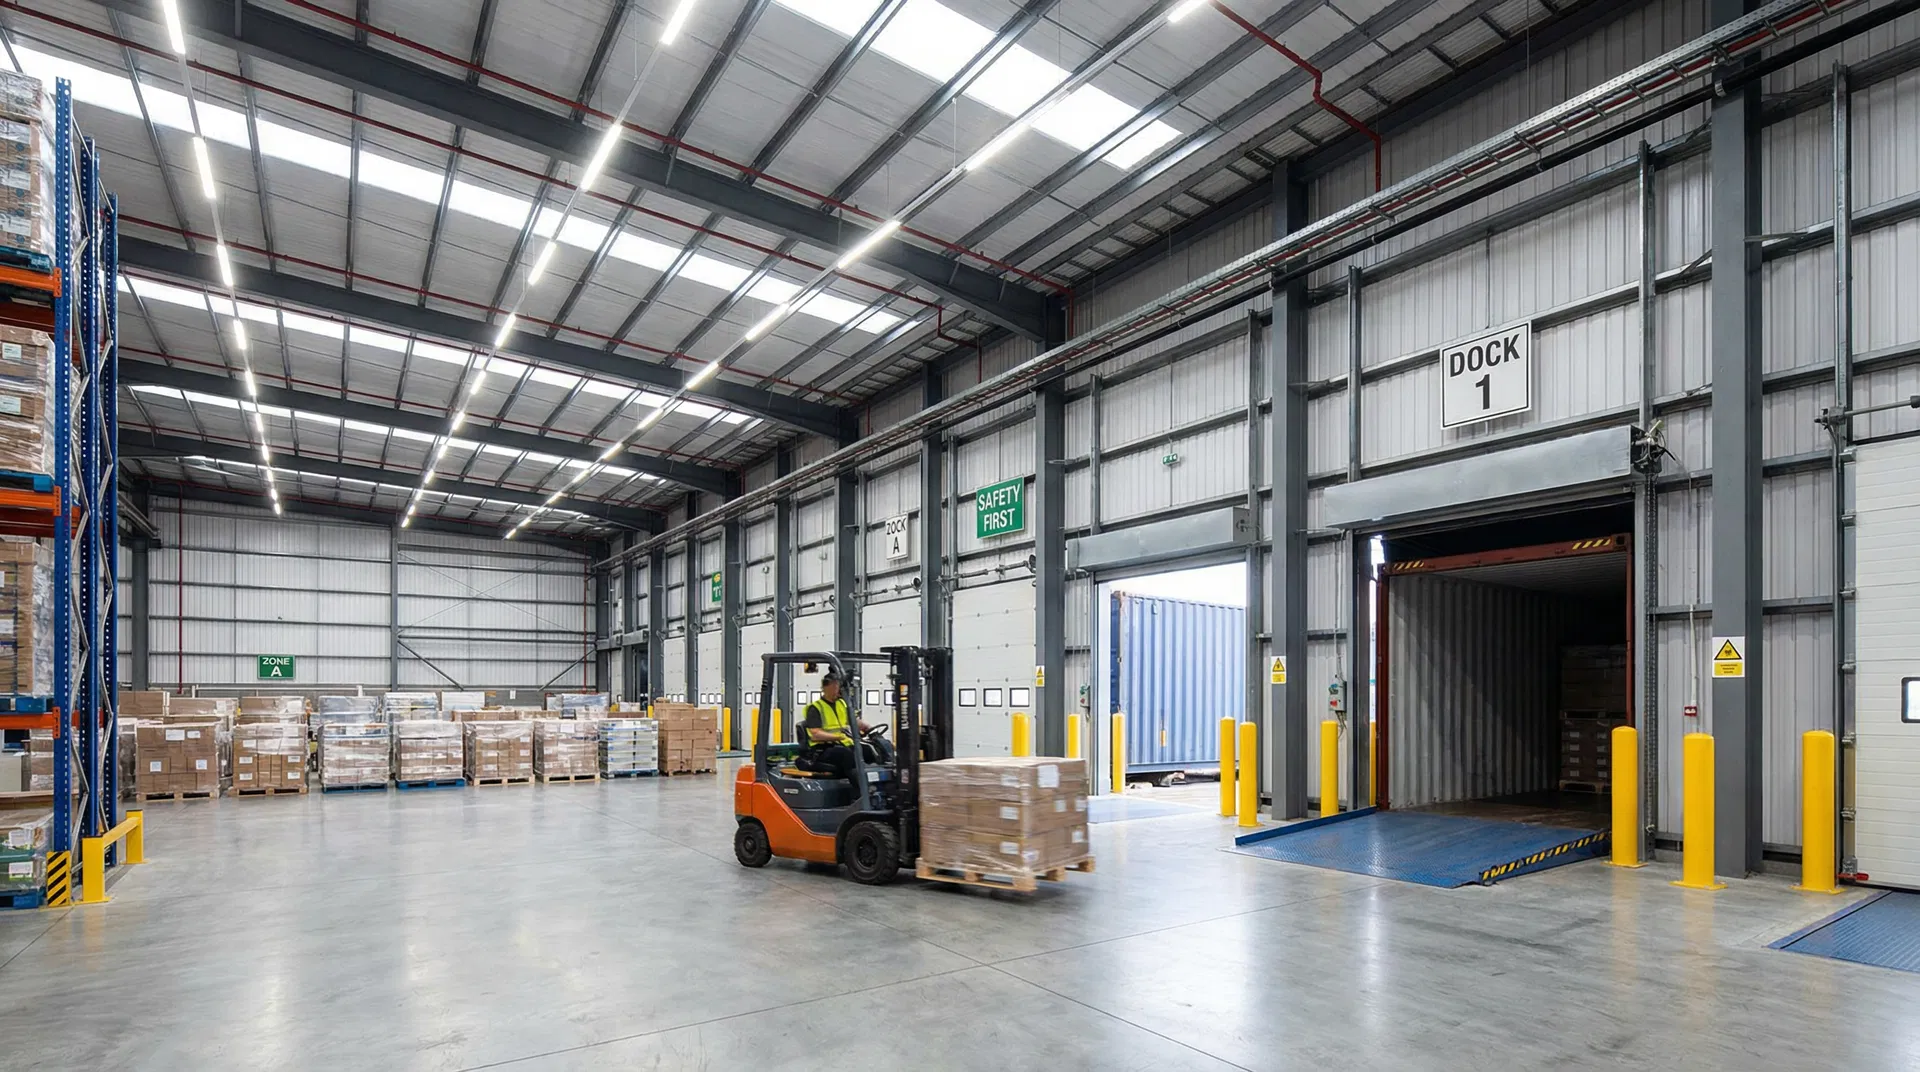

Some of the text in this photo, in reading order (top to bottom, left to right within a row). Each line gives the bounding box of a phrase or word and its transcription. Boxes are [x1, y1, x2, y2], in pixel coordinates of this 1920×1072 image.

[1450, 333, 1521, 378] DOCK
[1475, 373, 1491, 410] 1
[978, 483, 1021, 512] SAFETY
[983, 507, 1016, 532] FIRST
[892, 536, 900, 555] A
[262, 657, 291, 666] ZONE
[270, 665, 283, 677] A
